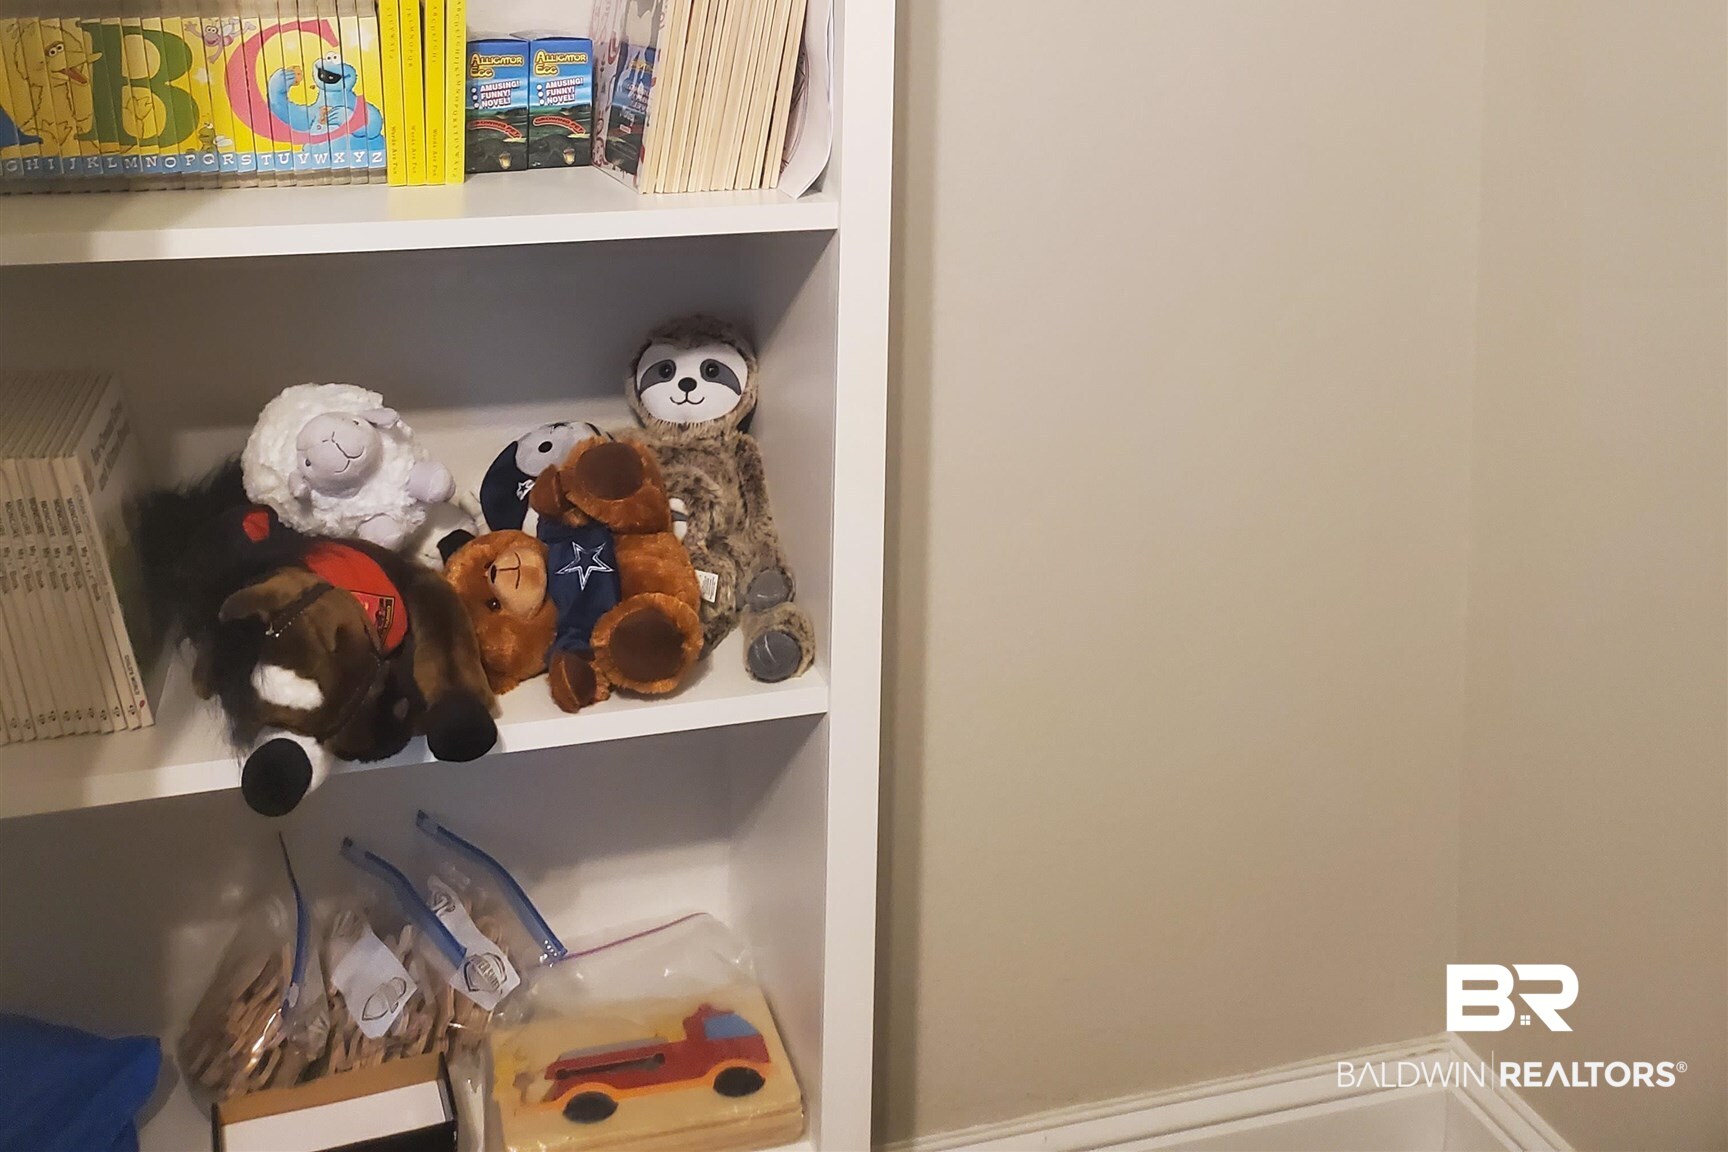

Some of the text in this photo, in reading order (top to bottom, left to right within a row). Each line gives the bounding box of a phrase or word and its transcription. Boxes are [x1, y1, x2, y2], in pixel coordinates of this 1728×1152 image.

[480, 80, 520, 92] AMUSING!
[545, 77, 584, 89] AMUSING!
[481, 89, 511, 100] FUNNY!
[546, 86, 575, 97] FUNNY!
[481, 98, 511, 108] NOVEL!
[546, 94, 575, 105] NOVEL!
[6, 151, 383, 172] G H I J K L M N O P Q R S T U V W X Y Z
